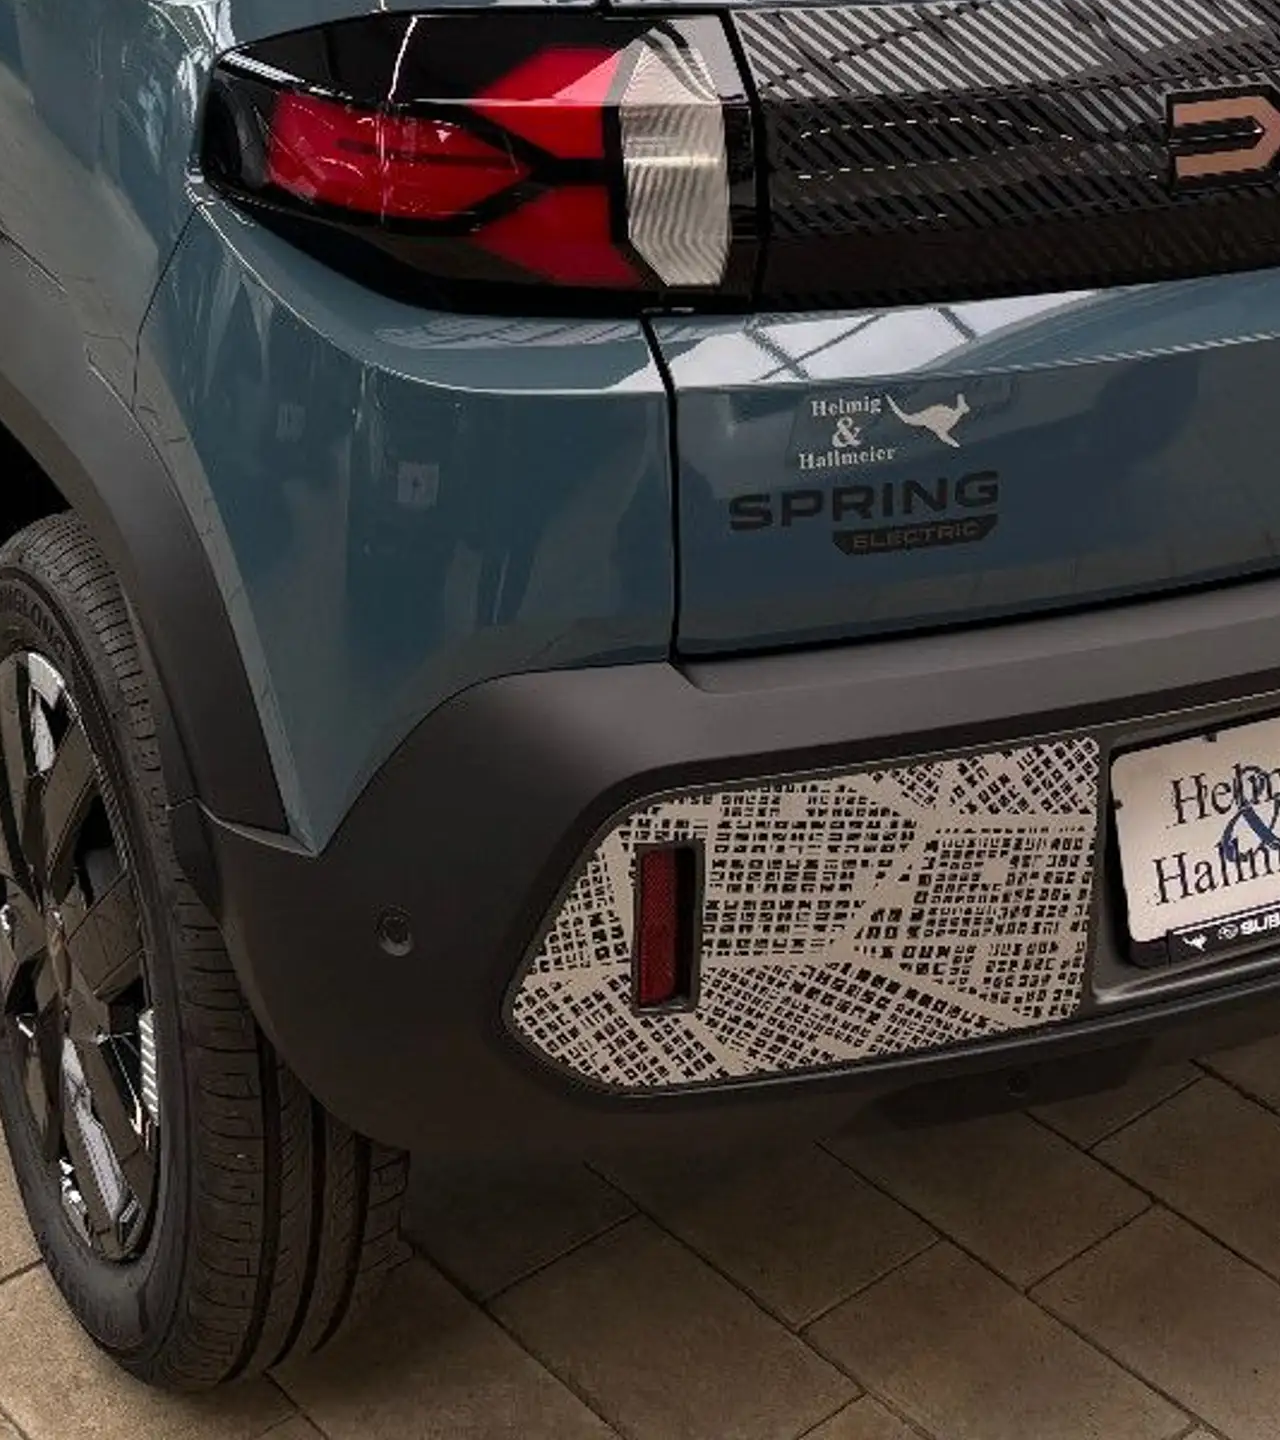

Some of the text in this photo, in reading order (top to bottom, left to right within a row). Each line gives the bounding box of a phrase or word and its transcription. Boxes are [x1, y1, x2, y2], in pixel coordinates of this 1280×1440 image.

[809, 394, 883, 418] Helmig
[831, 416, 862, 448] &
[798, 445, 897, 470] Hallmeier
[728, 470, 1000, 531] SPRING
[852, 521, 982, 549] ELECTRIC
